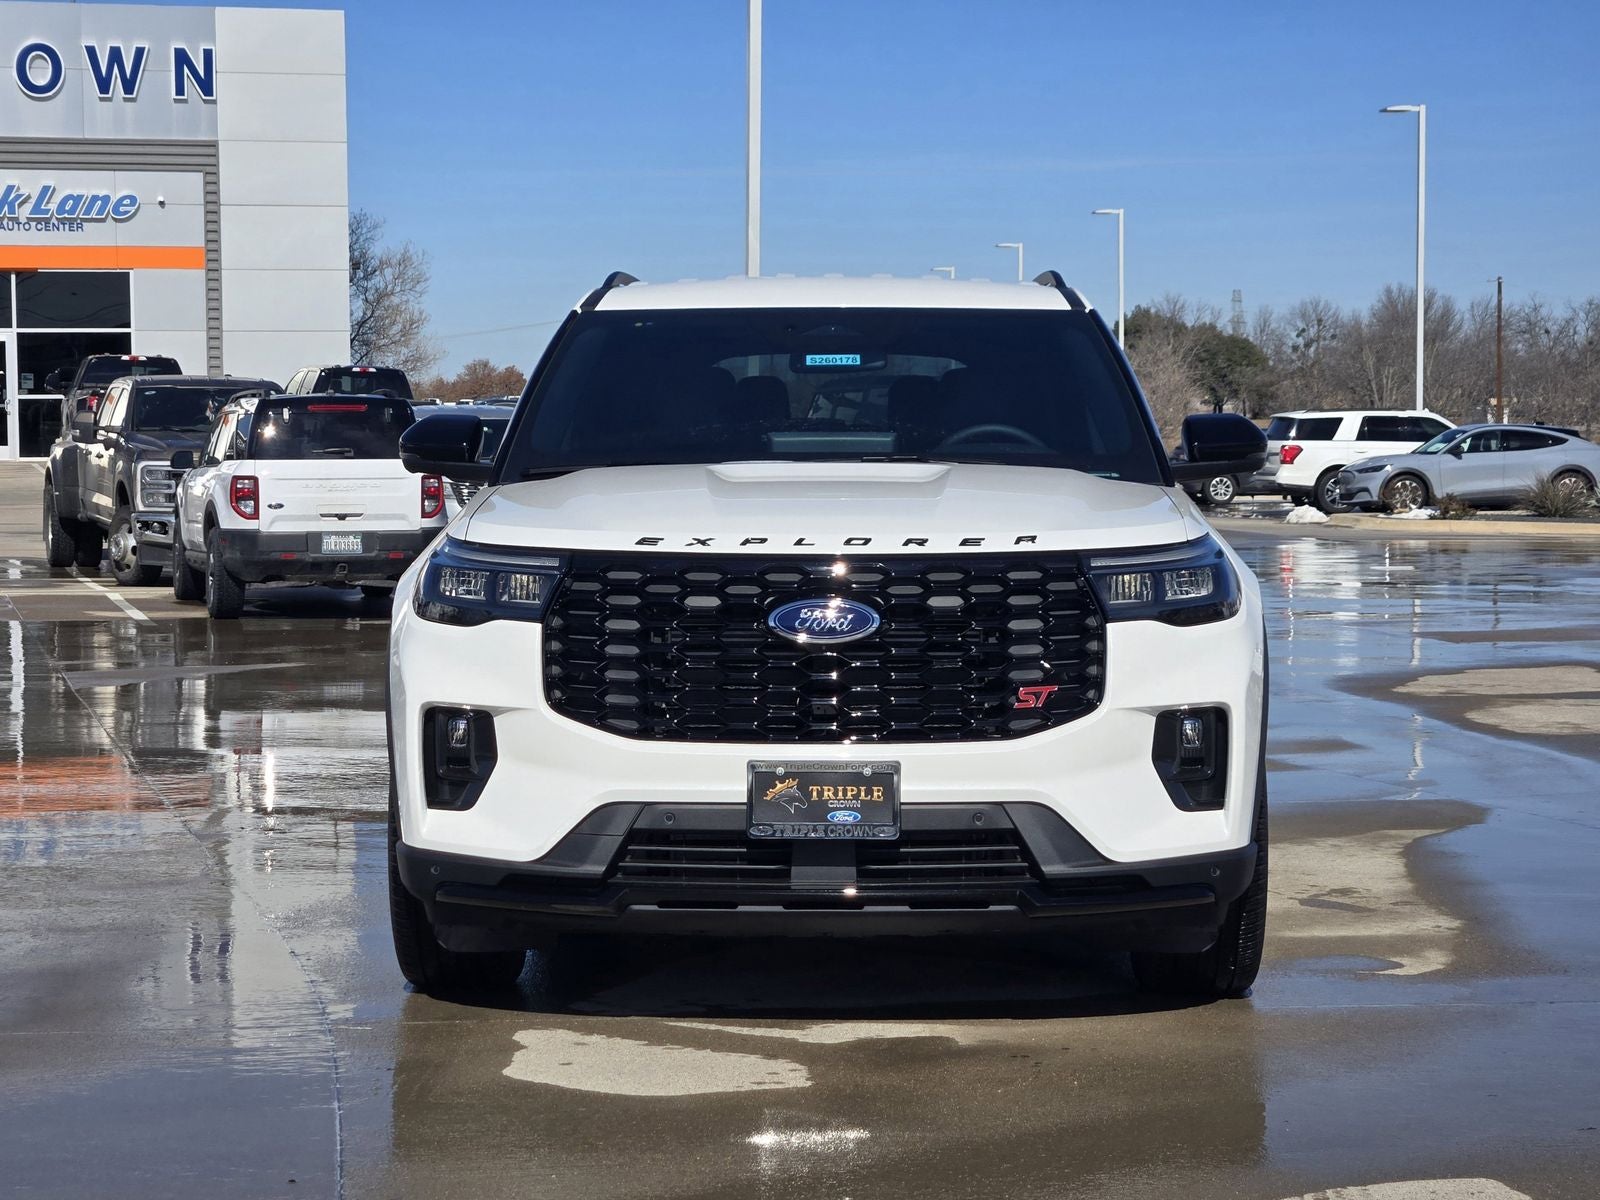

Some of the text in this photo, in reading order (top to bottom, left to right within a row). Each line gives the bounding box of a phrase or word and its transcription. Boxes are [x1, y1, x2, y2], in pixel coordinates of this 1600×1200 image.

[15, 41, 216, 99] OWN
[27, 184, 140, 219] Lane
[0, 222, 84, 232] AUTO CENTER
[809, 356, 858, 364] S260178
[634, 534, 1038, 547] EXPLORER
[1013, 685, 1058, 708] ST
[757, 762, 893, 771] wwwTripleCrownFordcom
[808, 786, 884, 801] TRIPLE
[828, 800, 861, 808] CROWN
[773, 824, 825, 837] TRIPLE
[828, 825, 873, 837] CROWN
